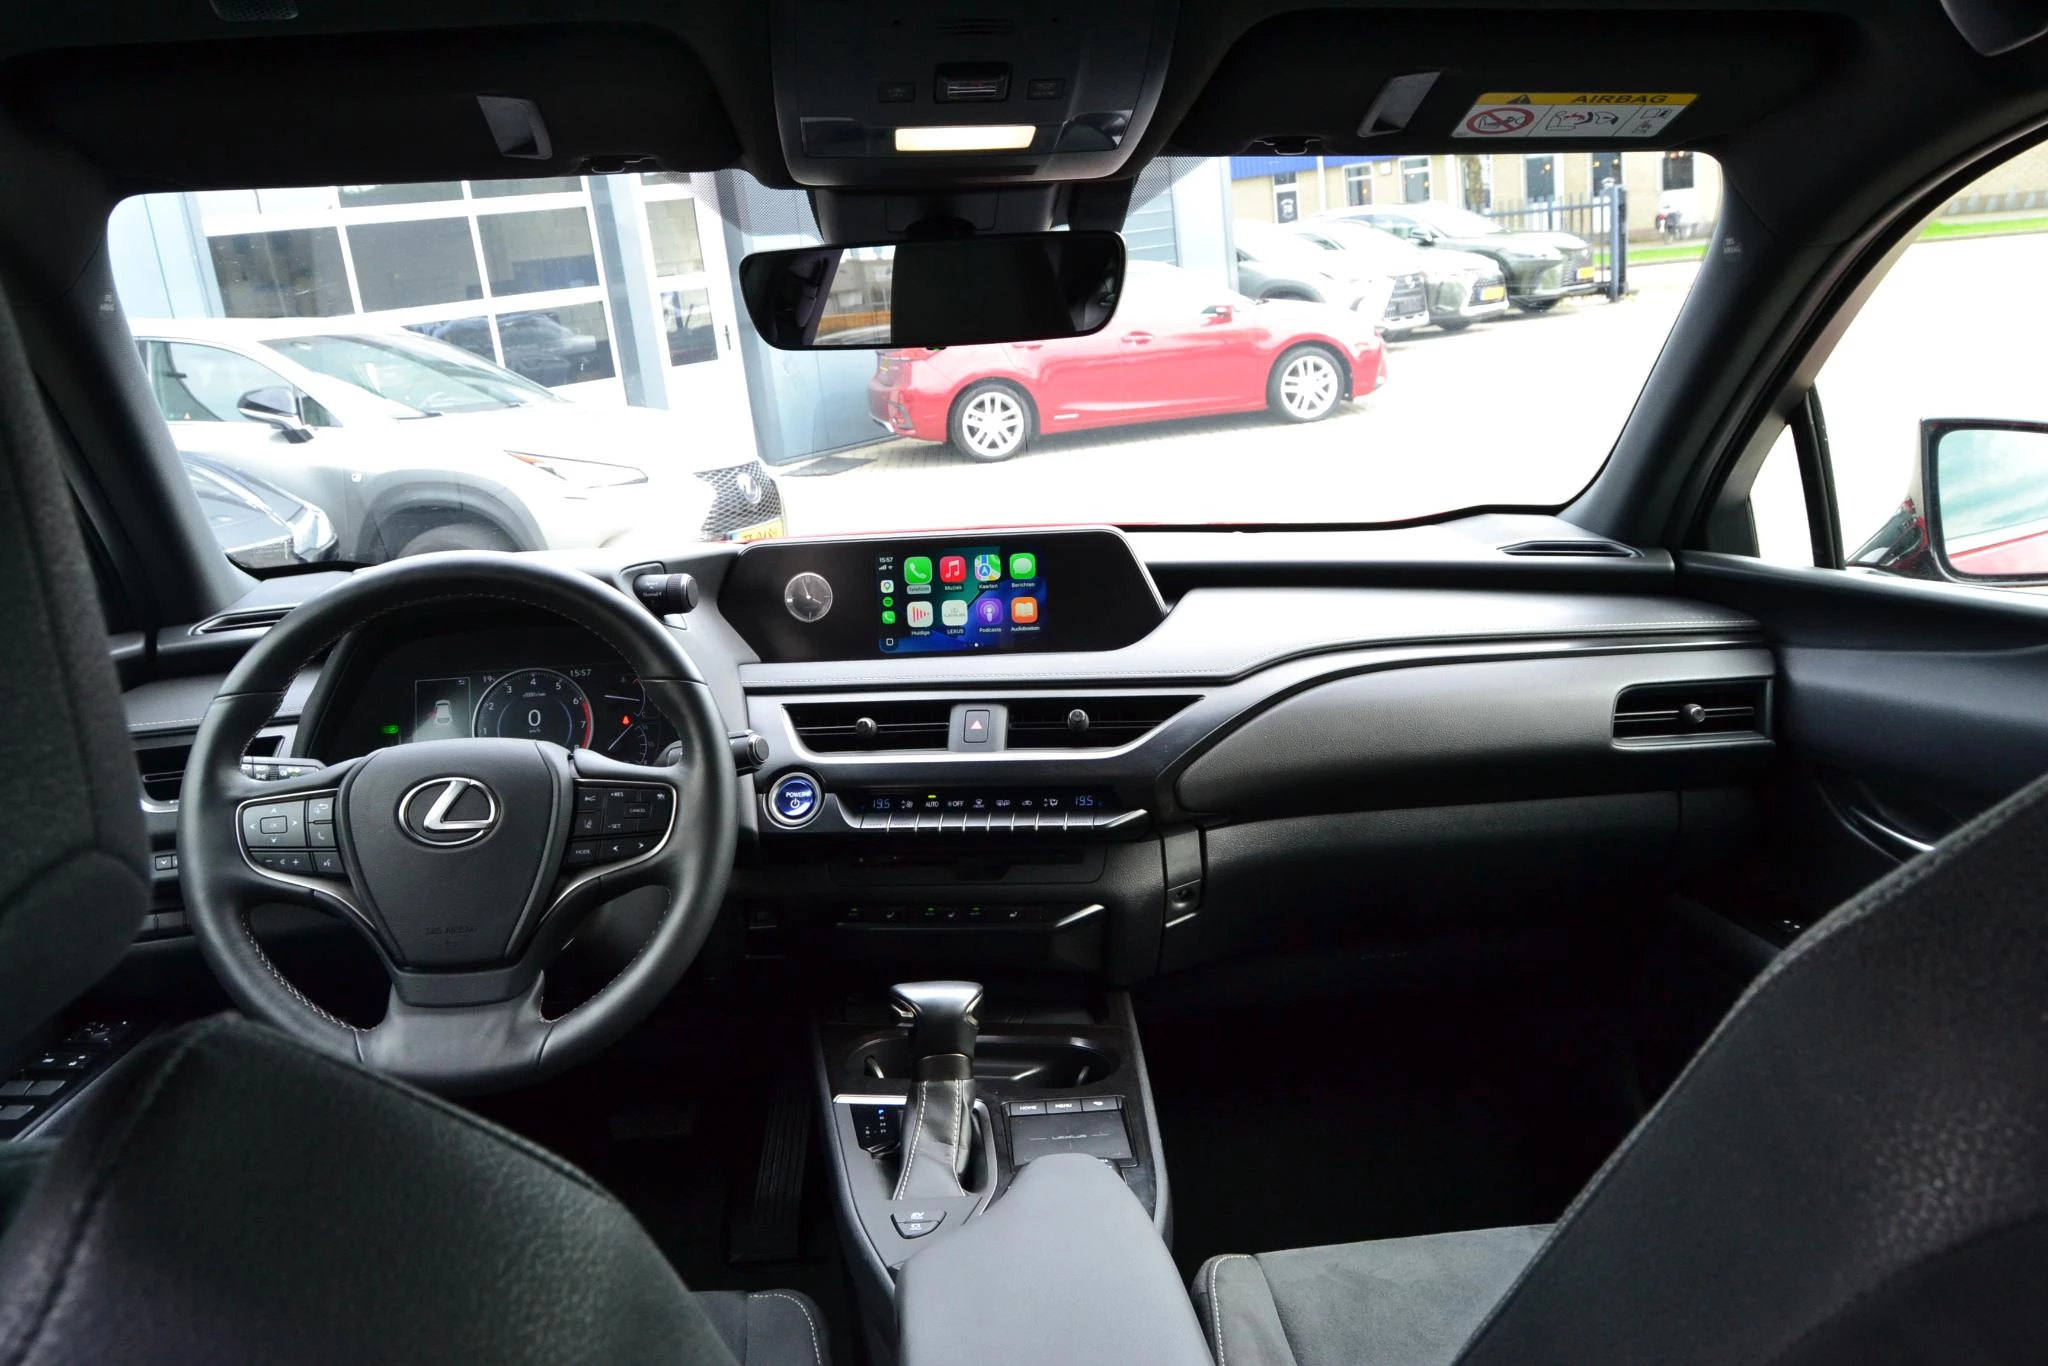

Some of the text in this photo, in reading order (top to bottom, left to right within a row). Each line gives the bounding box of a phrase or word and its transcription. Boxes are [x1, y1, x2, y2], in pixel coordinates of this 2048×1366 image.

[1570, 95, 1668, 104] AIRBAG
[570, 669, 592, 677] 15:57
[529, 677, 537, 686] 4
[506, 685, 513, 693] 3
[555, 682, 562, 690] 5
[572, 697, 579, 705] 6
[488, 702, 495, 710] 2
[528, 709, 541, 726] 0
